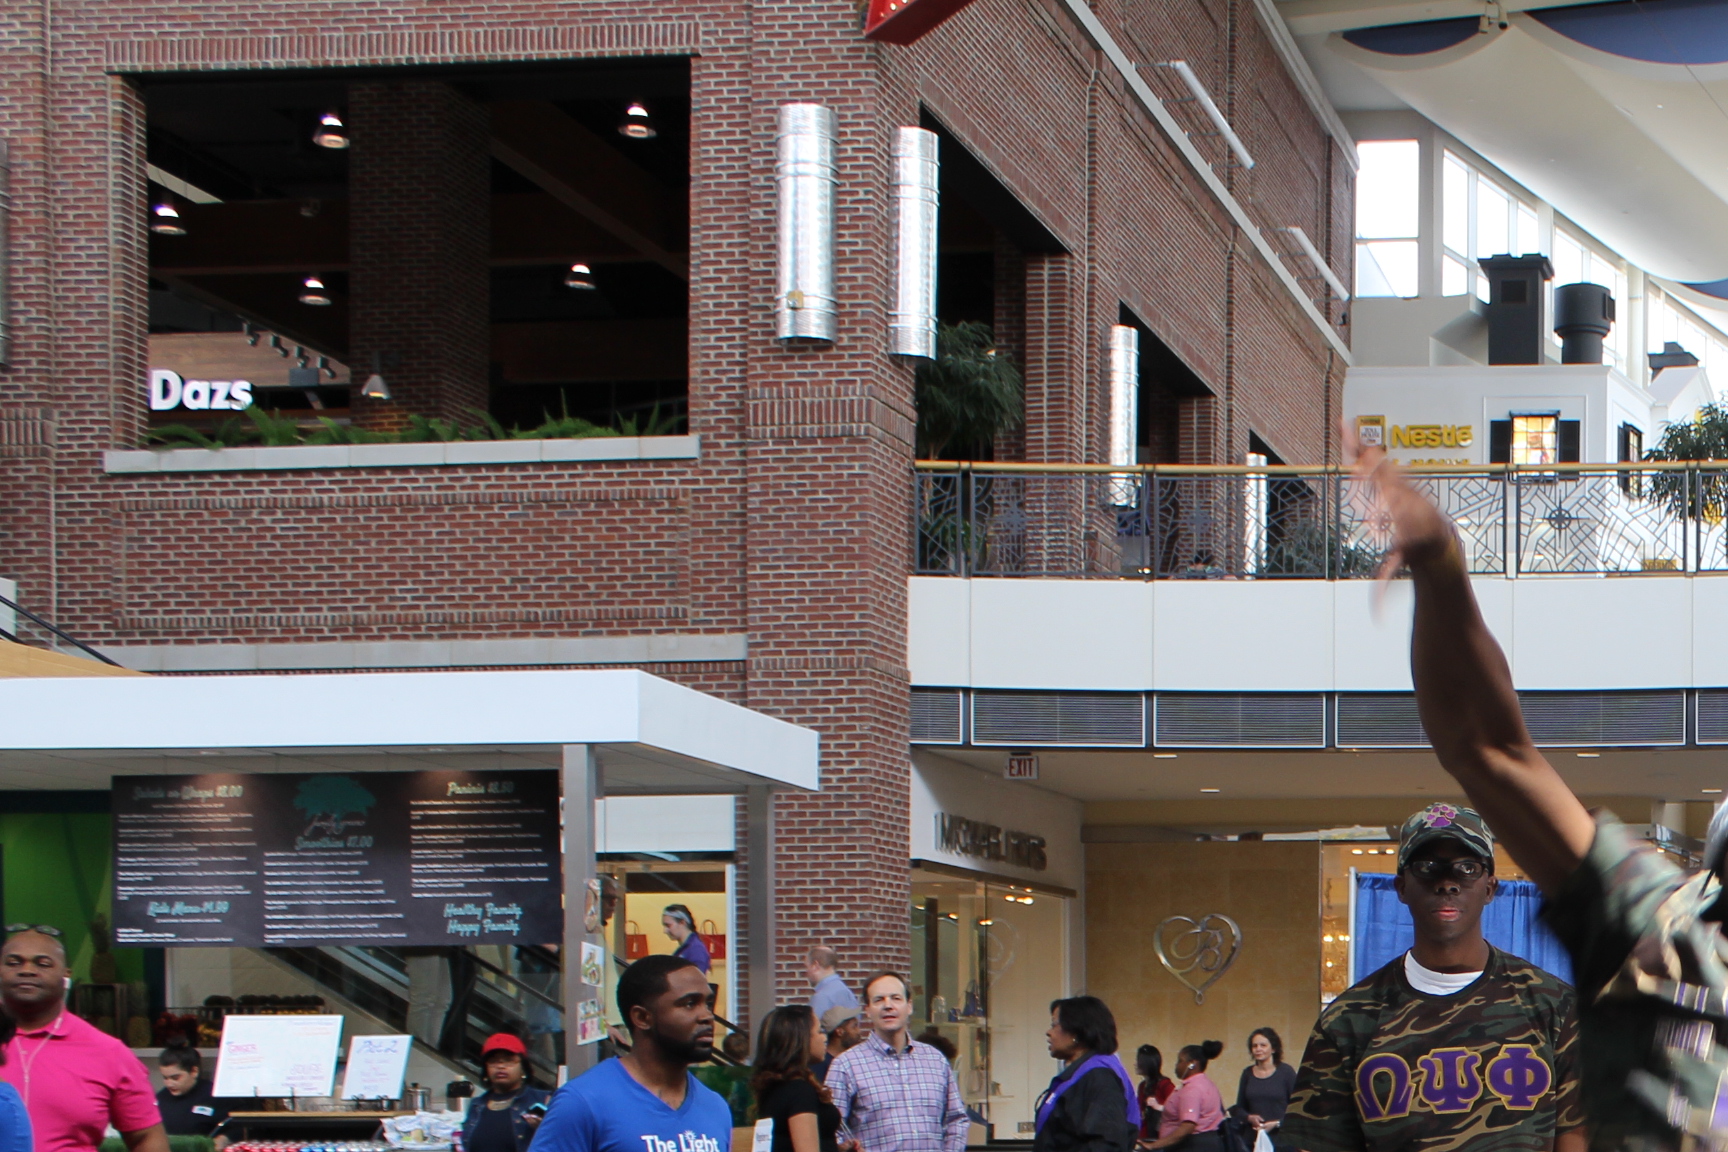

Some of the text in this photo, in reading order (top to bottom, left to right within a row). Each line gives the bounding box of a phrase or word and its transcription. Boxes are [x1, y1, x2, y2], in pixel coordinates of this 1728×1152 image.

[1391, 425, 1473, 448] Nestlé
[1008, 757, 1034, 777] EXIT
[1354, 1043, 1551, 1123] ΩΨΦ
